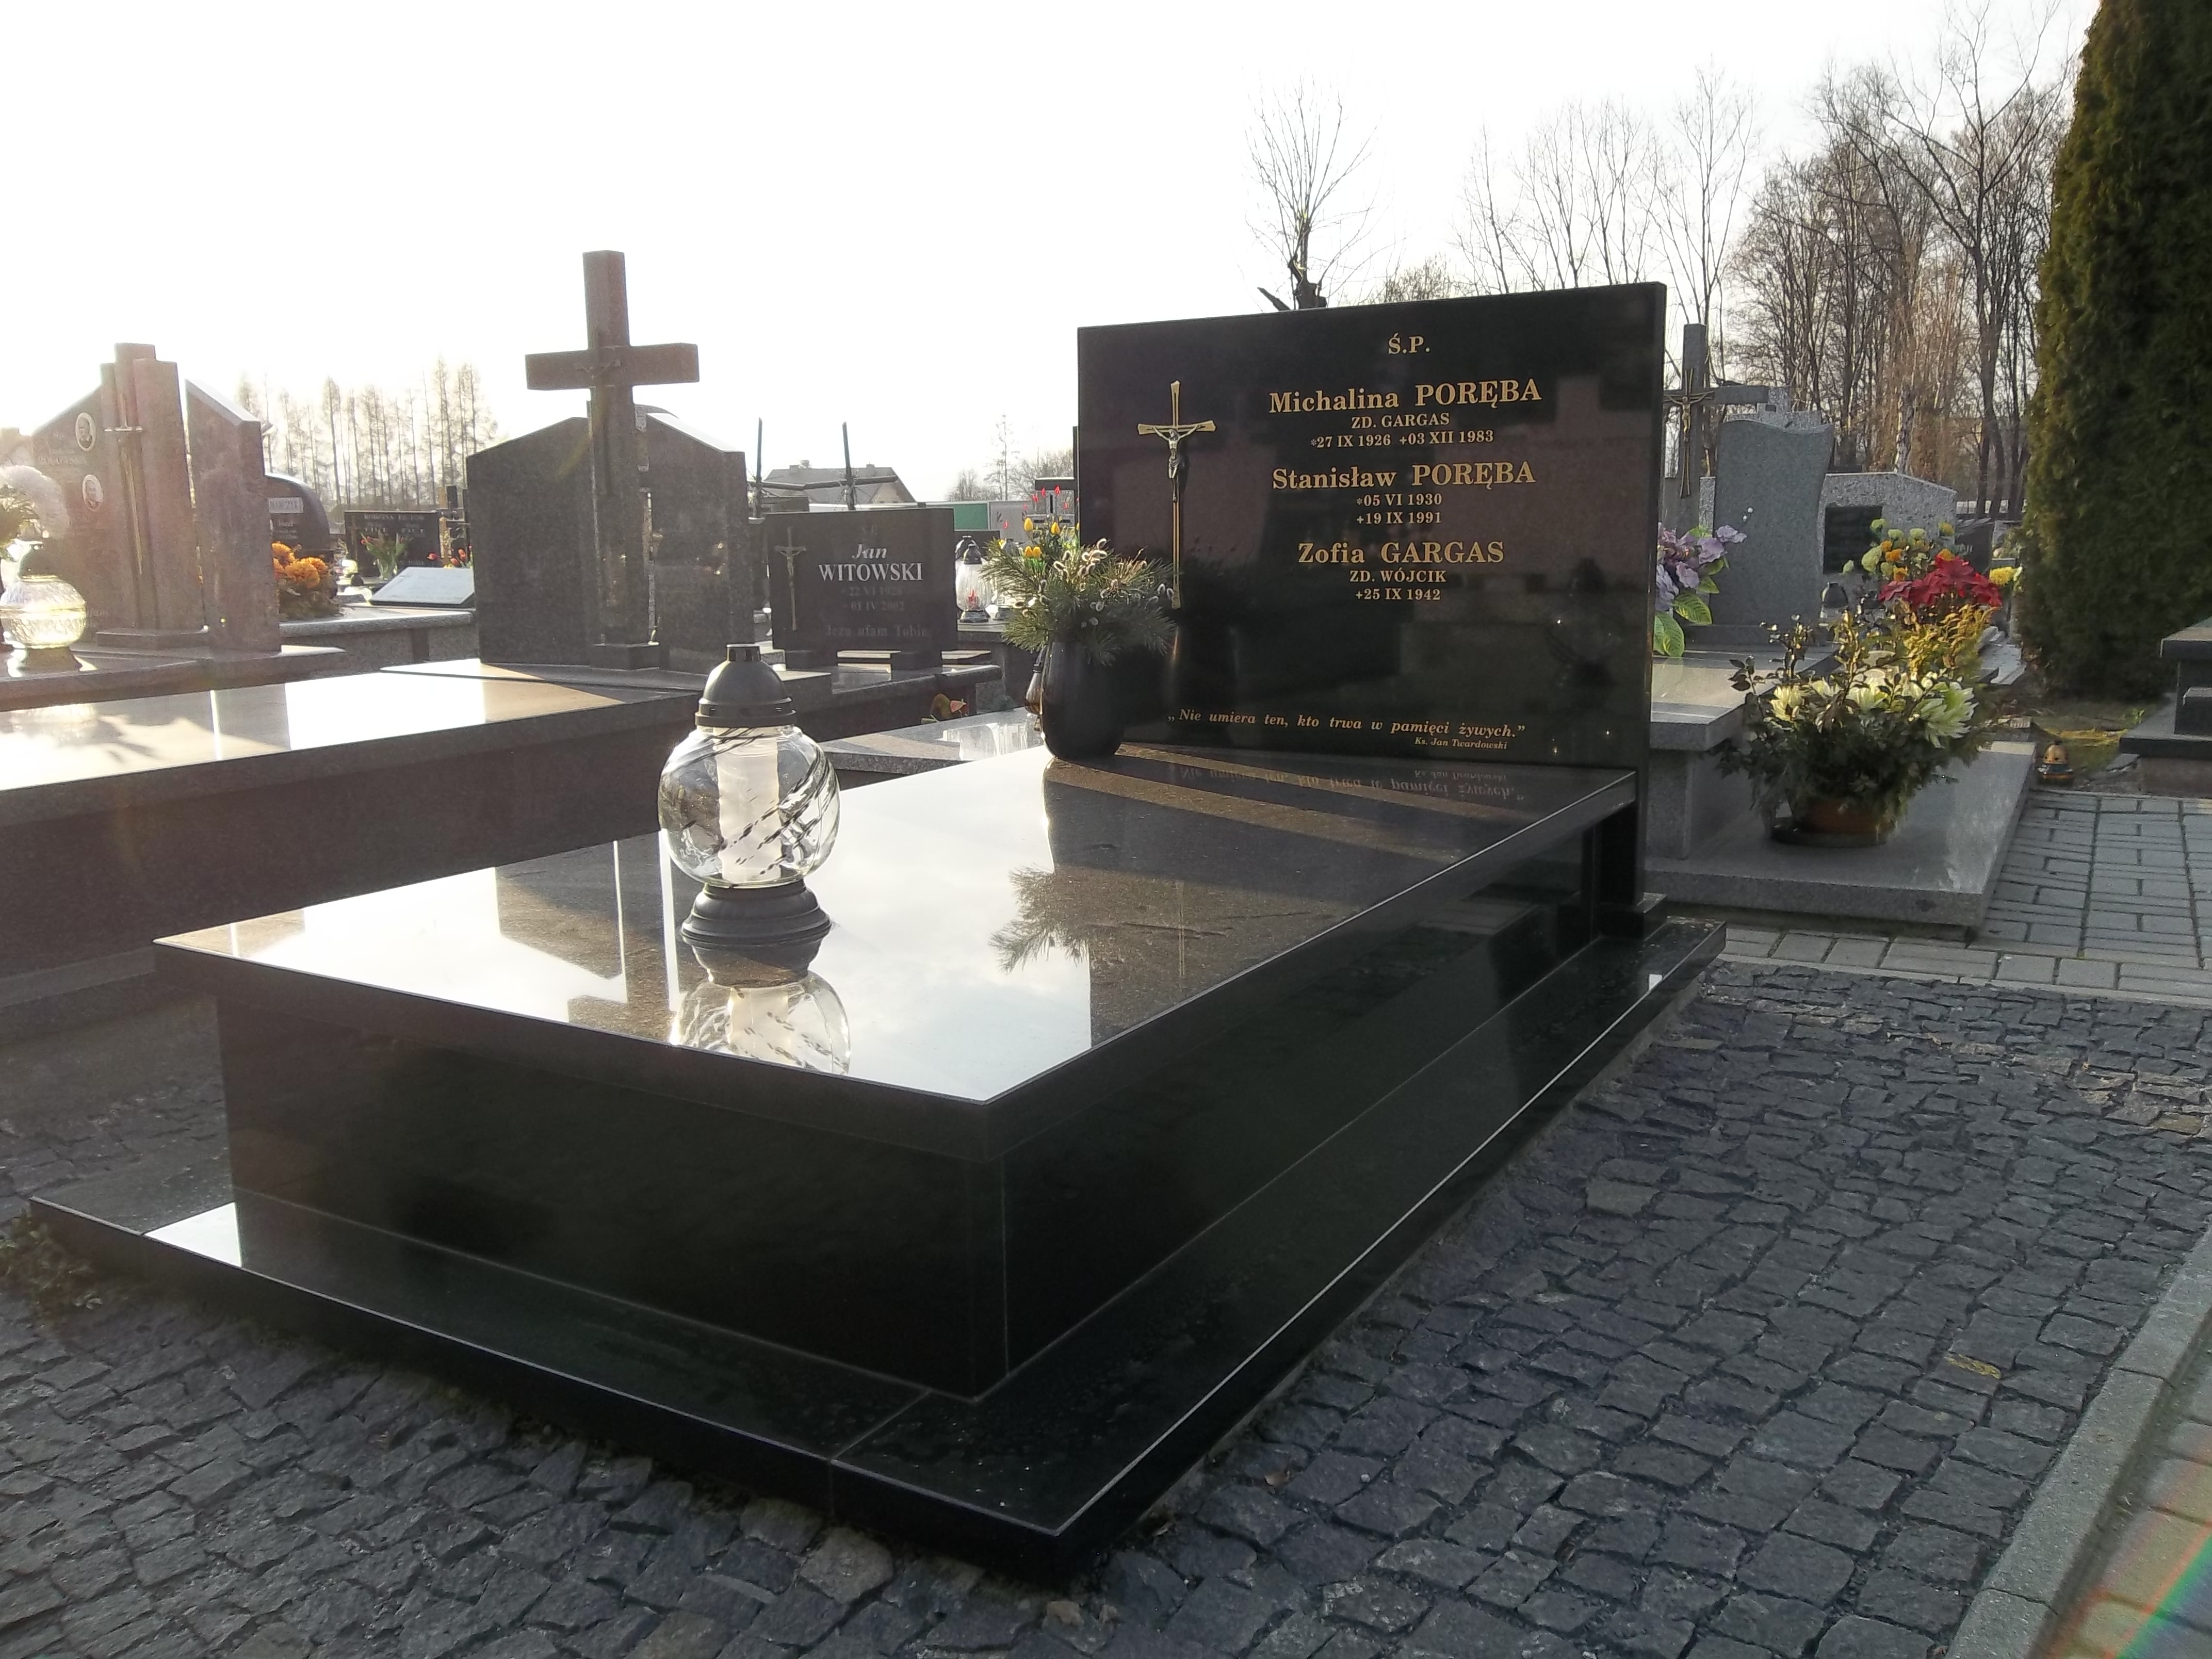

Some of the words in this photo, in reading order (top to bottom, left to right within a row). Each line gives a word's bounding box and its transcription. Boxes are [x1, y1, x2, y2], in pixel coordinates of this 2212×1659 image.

[1269, 388, 1400, 413] Michalina
[1415, 378, 1542, 409] PORĘBA
[1351, 415, 1376, 429] ZD.
[1381, 412, 1450, 428] GARGAS
[1337, 435, 1354, 447] IX
[1358, 434, 1391, 447] 1926
[1429, 431, 1454, 444] XII
[1459, 430, 1494, 444] 1983
[1273, 466, 1397, 490] Stanisław
[1411, 461, 1536, 490] PORĘBA
[1385, 494, 1402, 506] VI
[1408, 493, 1442, 506] 1930
[1386, 512, 1403, 524] IX
[1408, 511, 1442, 525] 1991
[852, 544, 887, 560] Jan
[1298, 542, 1365, 564] Zofia
[1381, 541, 1504, 563] GARGAS
[818, 563, 923, 581] WITOWSKI
[1349, 570, 1375, 583] ZD.
[1380, 567, 1447, 583] WÓJCIK
[1385, 588, 1403, 600] IX
[1407, 588, 1441, 600] 1942
[1209, 711, 1256, 724] umiera
[1264, 714, 1289, 728] ten,
[1297, 714, 1320, 727] kto
[1329, 717, 1362, 729] trwa
[1371, 722, 1383, 730] w
[1390, 721, 1450, 736] pamięci
[1414, 737, 1428, 746] Ks.
[1430, 738, 1449, 747] Jan
[1452, 739, 1507, 750] Twardowski
